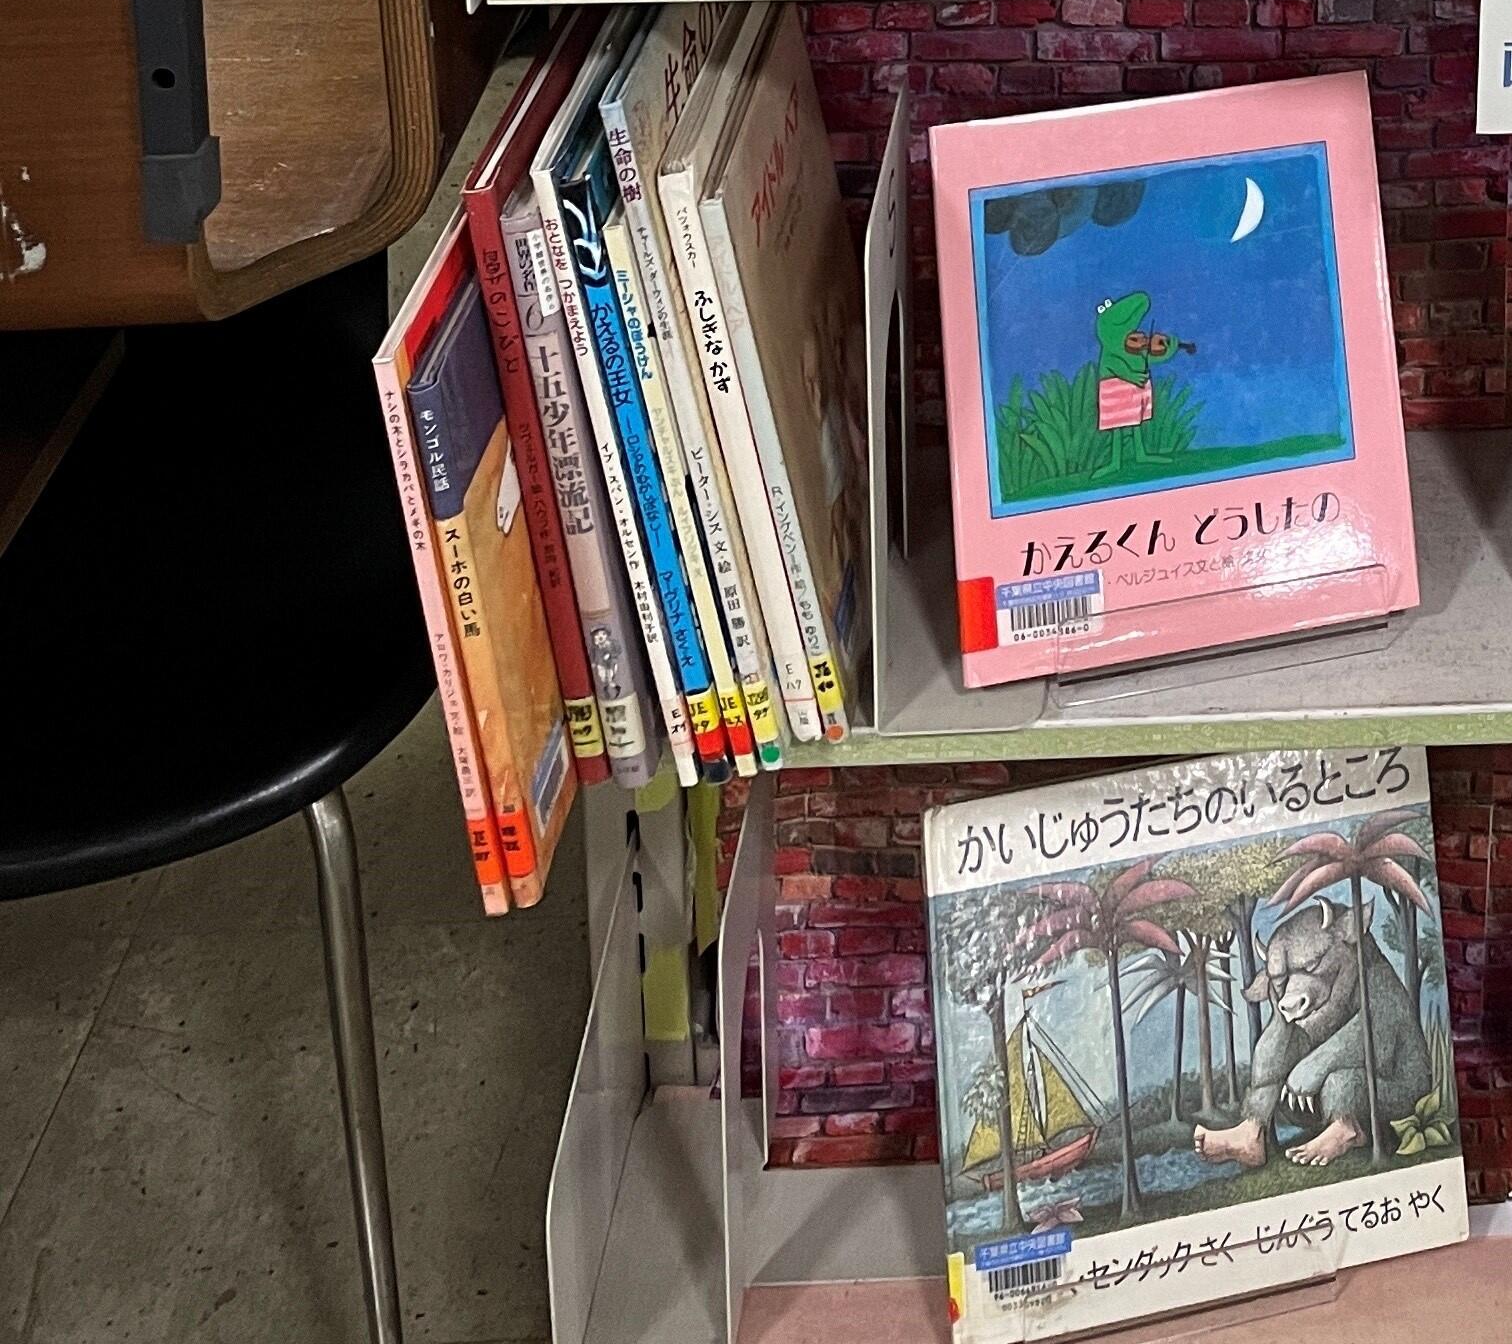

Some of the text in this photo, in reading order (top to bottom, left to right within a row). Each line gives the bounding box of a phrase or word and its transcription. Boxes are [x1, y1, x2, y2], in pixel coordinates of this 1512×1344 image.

[543, 219, 589, 357] おとなを つかまえよう
[608, 128, 726, 535] 生命の樹 ピーター・シス
[615, 269, 653, 381] ミーシャのぼうけん
[694, 289, 733, 395] ふしぎな かず
[589, 301, 633, 408] かえるの王女
[419, 408, 451, 493] モンゴル民話
[531, 342, 595, 535] 十五少年漂流記
[444, 528, 482, 639] スーホの白い馬
[1018, 491, 1342, 576] かえるくん どうしたの
[955, 749, 1412, 875] かいじゅうたちのいるところ
[1200, 1184, 1445, 1266] さく じんぐう てるお やく
